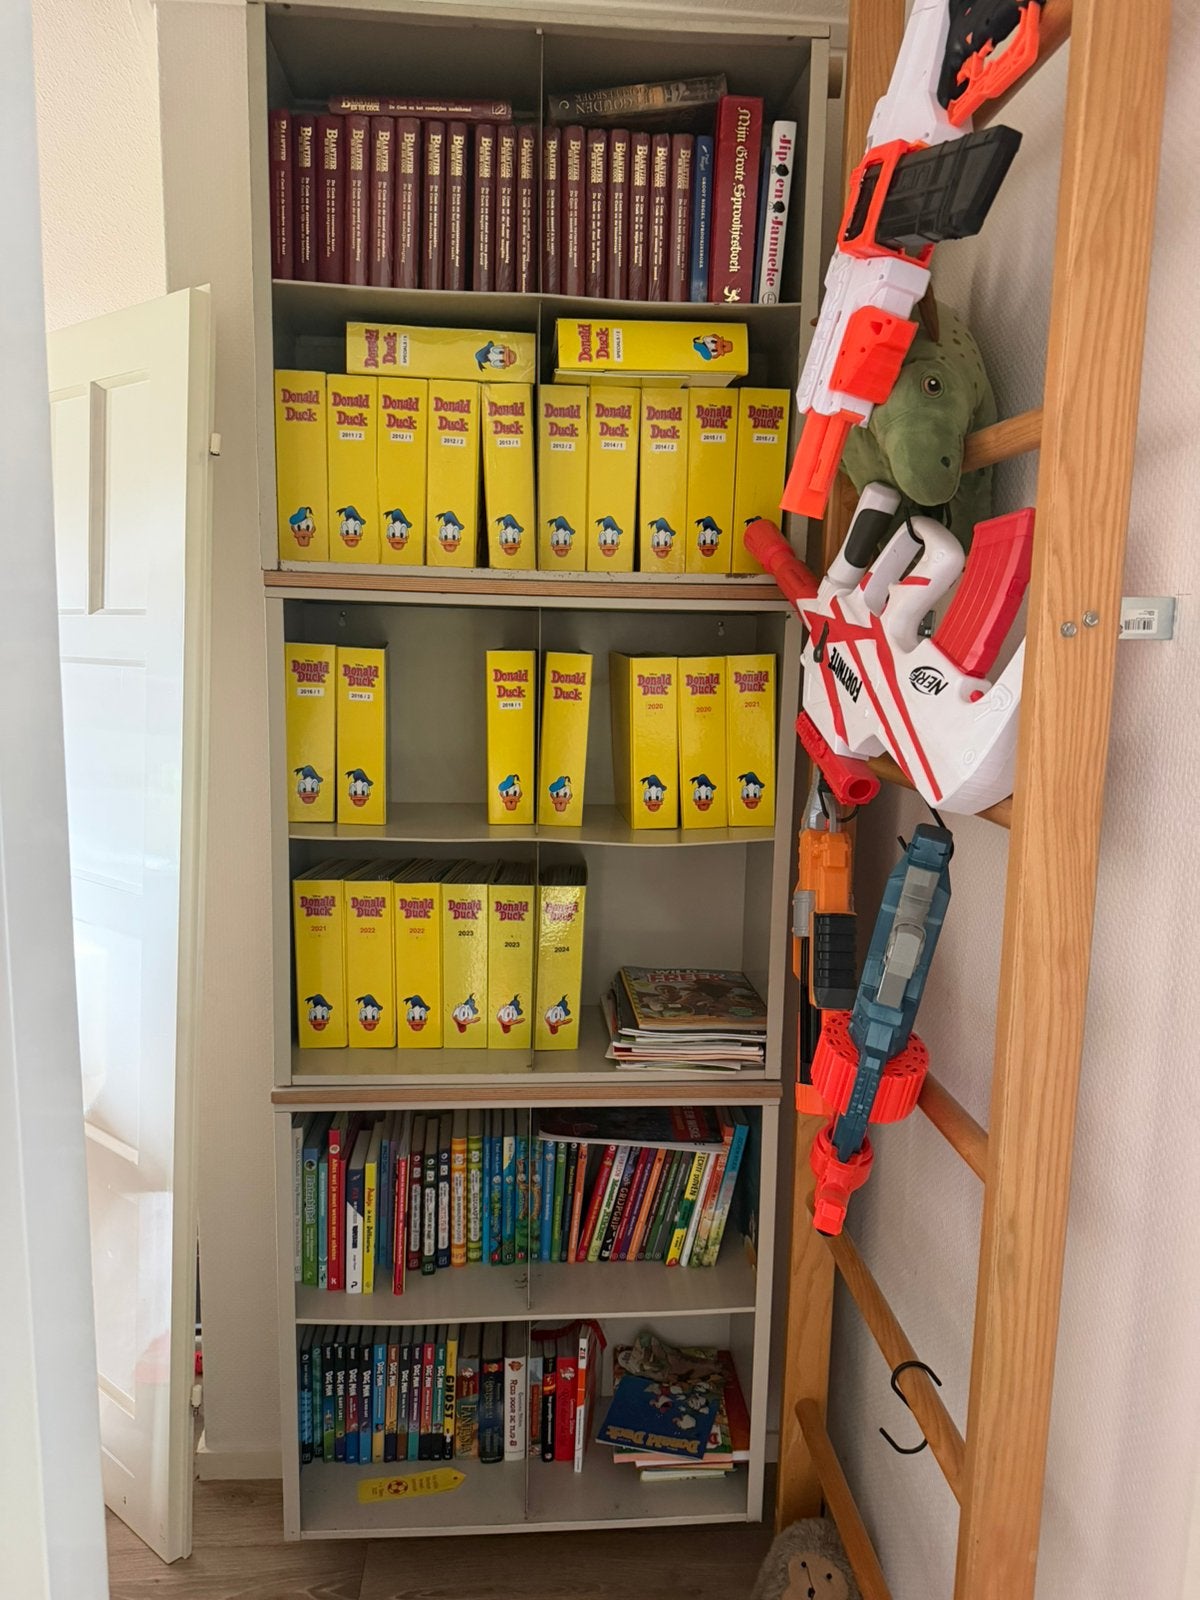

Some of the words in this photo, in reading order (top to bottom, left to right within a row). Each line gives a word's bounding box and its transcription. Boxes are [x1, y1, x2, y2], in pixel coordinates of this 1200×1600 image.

[576, 95, 632, 114] GOUDEN
[735, 107, 750, 142] Mijn
[775, 134, 792, 161] Jip
[734, 146, 748, 180] Grote
[774, 179, 785, 199] en
[729, 183, 746, 273] Sprookjesboek
[766, 216, 783, 287] Janneke
[364, 330, 380, 368] Donald
[382, 332, 397, 364] Duck
[578, 324, 592, 363] Donald
[596, 328, 609, 359] Duck
[282, 389, 320, 405] Donald
[331, 392, 370, 409] Donald
[382, 394, 420, 412] Donald
[432, 397, 470, 414] Donald
[486, 402, 524, 417] Donald
[545, 405, 580, 419] Donald
[594, 403, 631, 421] Donald
[695, 405, 733, 420] Donald
[747, 405, 784, 420] Donald
[286, 408, 316, 422] Duck
[336, 410, 366, 428] Duck
[386, 412, 416, 430] Duck
[645, 405, 683, 422] Donald
[437, 414, 468, 432] Duck
[493, 419, 523, 436] Duck
[548, 422, 577, 437] Duck
[599, 422, 628, 437] Duck
[699, 416, 728, 430] Duck
[751, 416, 780, 430] Duck
[650, 424, 679, 440] Duck
[292, 661, 329, 674] Donald
[342, 666, 380, 678] Donald
[828, 647, 862, 703] FORTNITE
[298, 672, 326, 683] Duck
[348, 675, 376, 688] Duck
[492, 669, 528, 682] Donald
[551, 670, 586, 686] Donald
[637, 673, 671, 687] Donald
[685, 673, 720, 687] Donald
[734, 671, 769, 684] Donald
[910, 670, 948, 696] NERF
[496, 685, 526, 699] Duck
[553, 686, 582, 701] Duck
[642, 684, 668, 696] Duck
[689, 684, 716, 697] Duck
[738, 681, 766, 693] Duck
[300, 896, 336, 910] Donald
[351, 898, 385, 911] Donald
[399, 898, 433, 912] Donald
[448, 900, 480, 912] Donald
[495, 902, 528, 913] Donald
[305, 907, 333, 917] Duck
[355, 908, 383, 918] Duck
[403, 909, 429, 921] Duck
[452, 909, 475, 920] Duck
[499, 911, 523, 921] Duck
[349, 1369, 357, 1382] DOG
[363, 1370, 371, 1384] DOG
[445, 1376, 454, 1420] GHOST
[460, 1405, 476, 1454] FANTASIA
[606, 1424, 644, 1444] Duck
[646, 1433, 700, 1454] Donald
